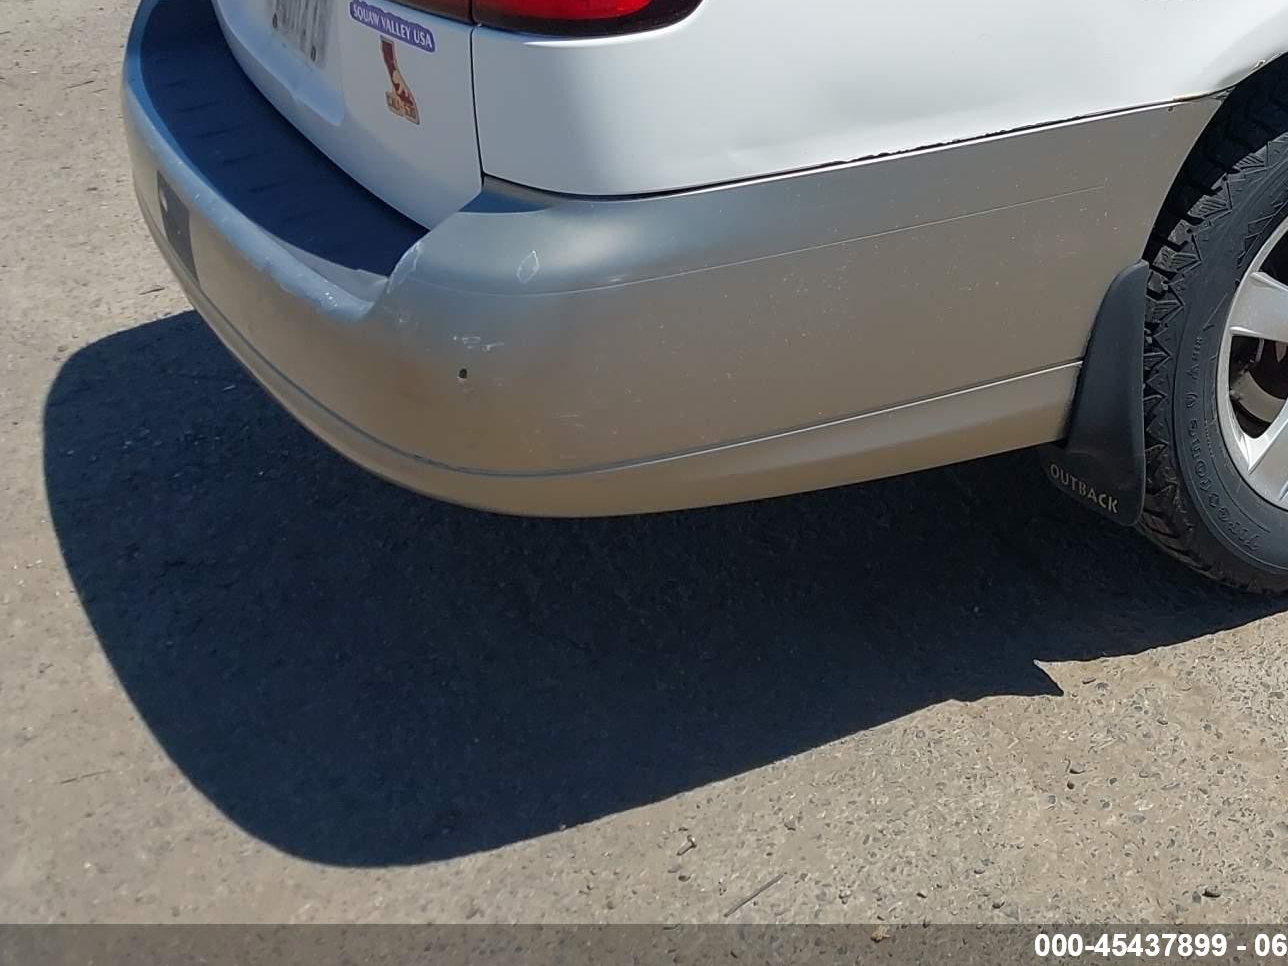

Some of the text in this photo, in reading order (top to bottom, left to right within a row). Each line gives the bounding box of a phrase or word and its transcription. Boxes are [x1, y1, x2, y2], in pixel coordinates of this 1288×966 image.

[352, 3, 433, 48] SQUAW VALLEY USA
[1050, 464, 1119, 513] OUTBACK
